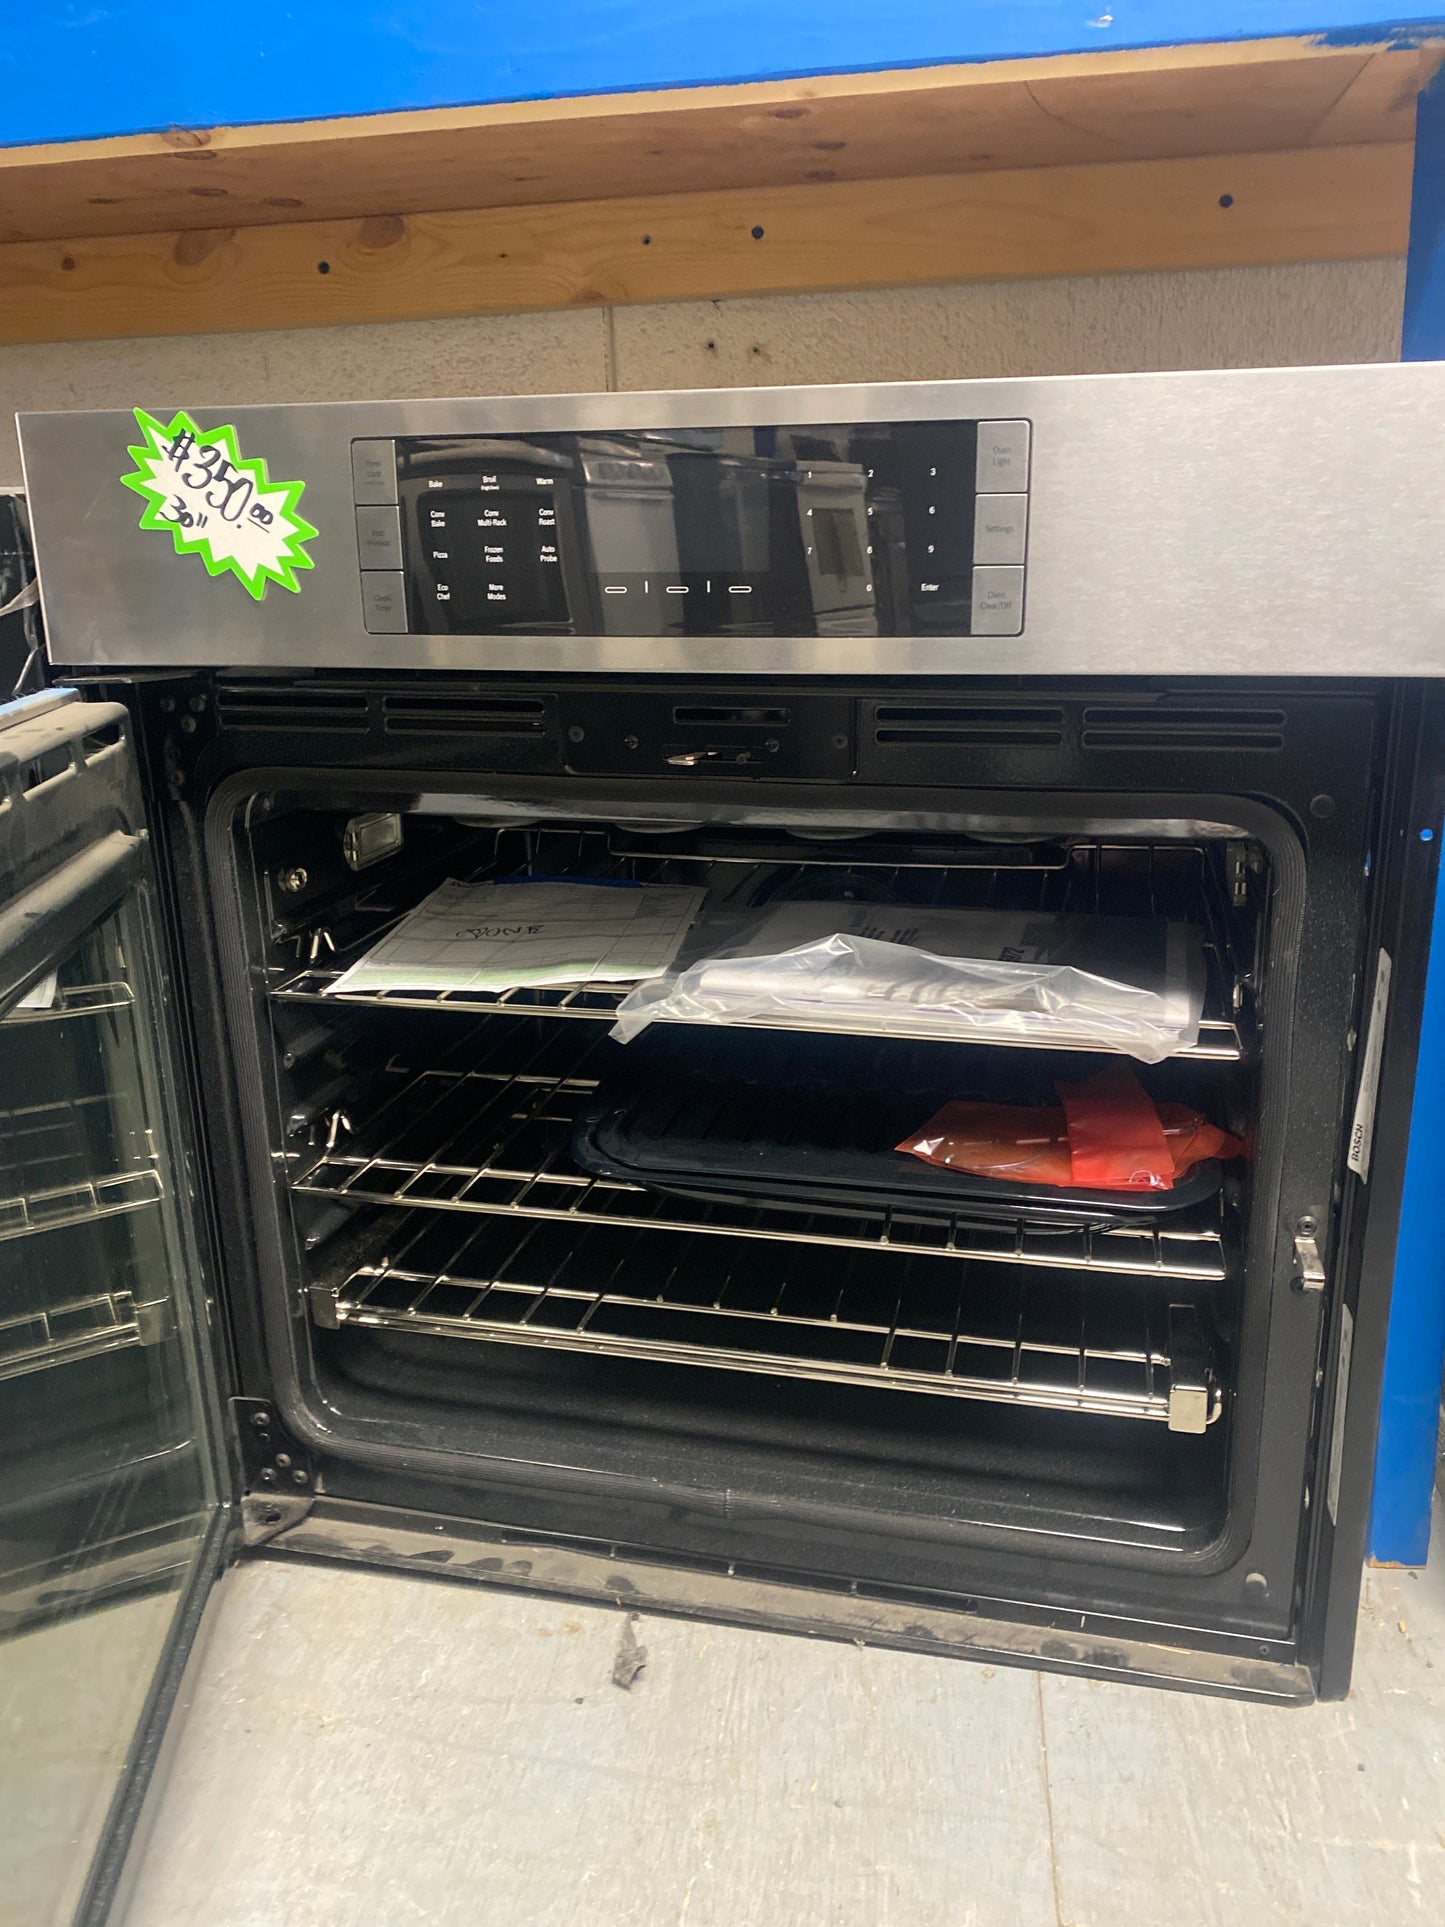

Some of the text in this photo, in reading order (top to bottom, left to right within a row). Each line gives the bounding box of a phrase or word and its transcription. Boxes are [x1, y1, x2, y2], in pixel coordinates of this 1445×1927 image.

[868, 469, 874, 477] 2
[428, 480, 443, 488] Bake
[929, 506, 935, 514] 6
[986, 524, 1014, 534] Settings
[541, 545, 556, 553] Auto
[928, 545, 934, 553] 9
[486, 555, 504, 563] Foods
[866, 584, 872, 592] 0
[921, 583, 939, 591] Enter
[1351, 1124, 1364, 1162] BOSCH
